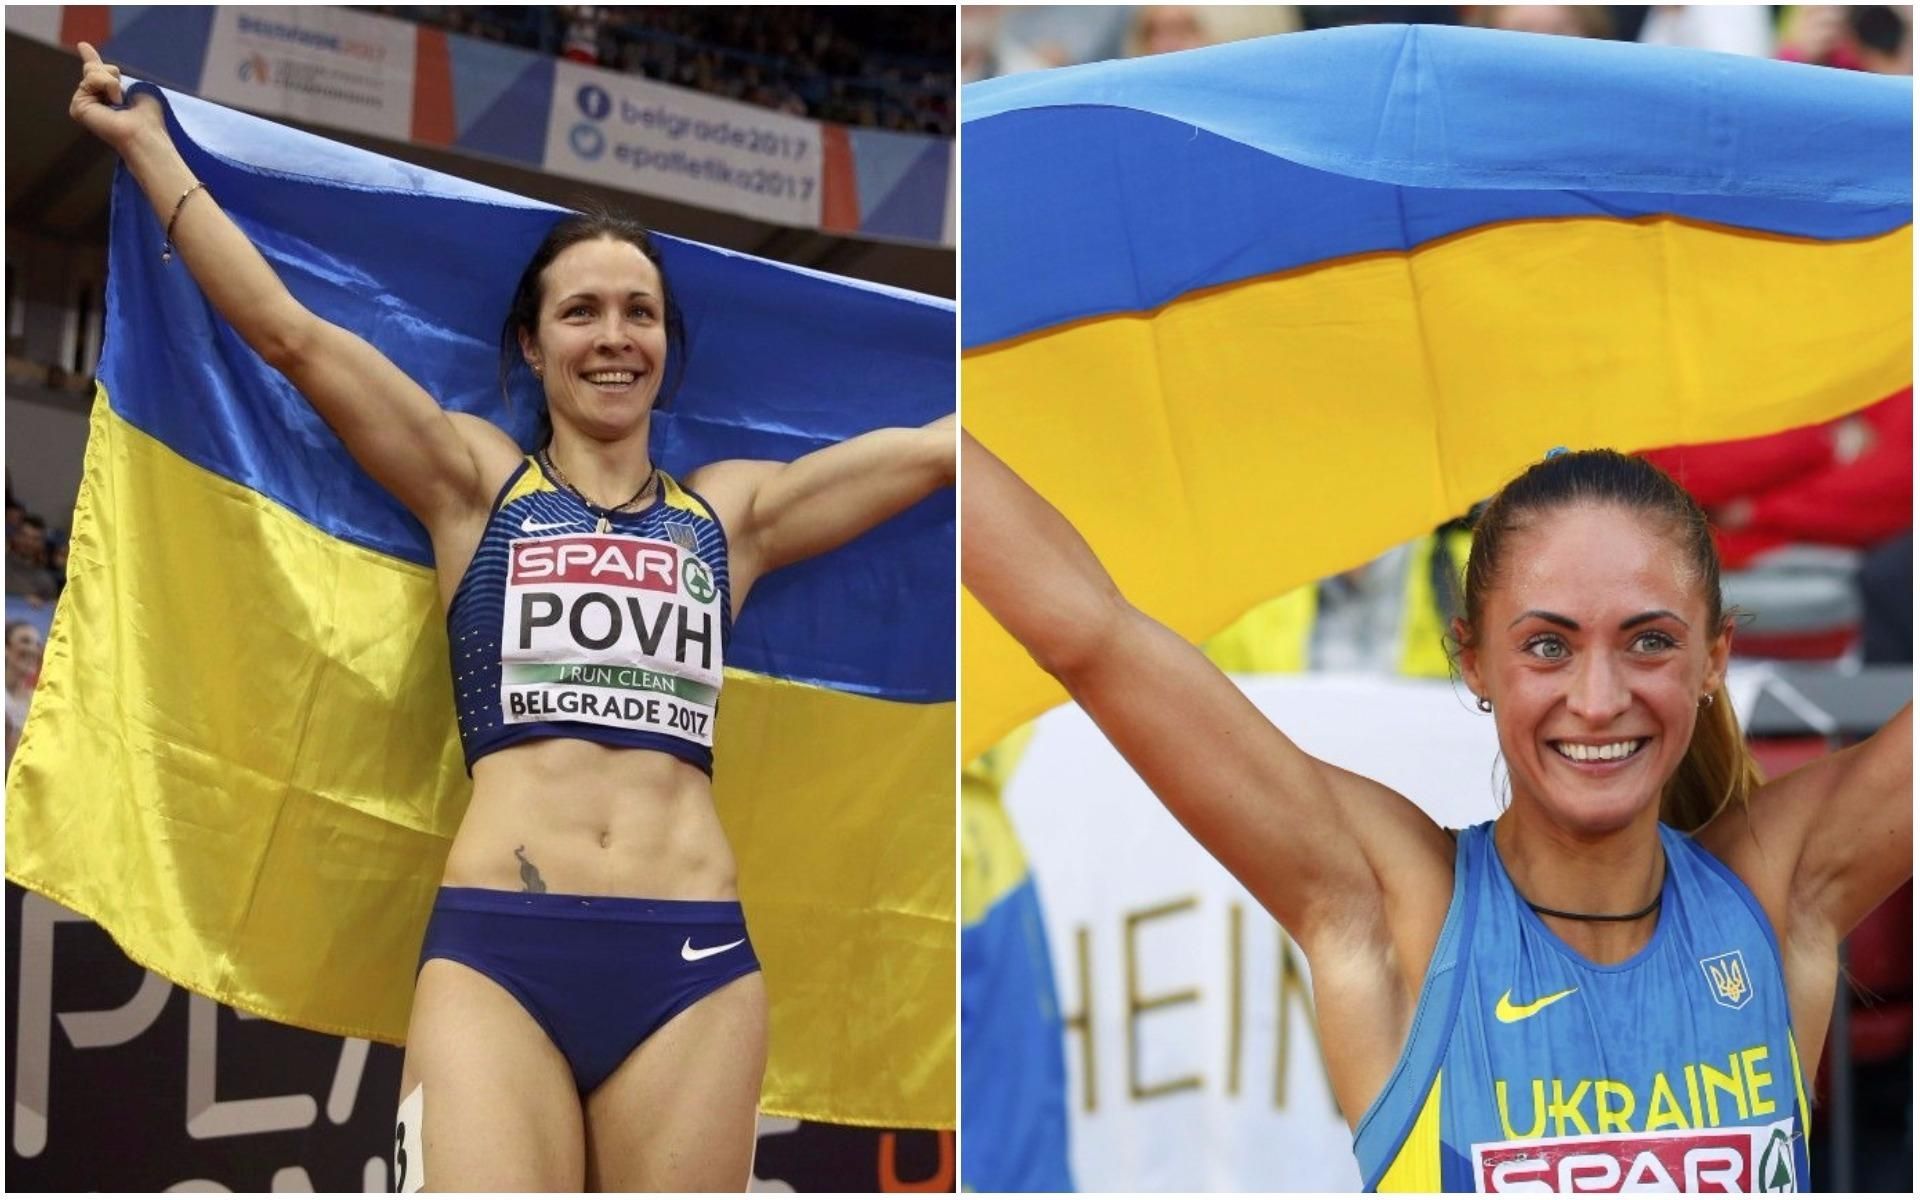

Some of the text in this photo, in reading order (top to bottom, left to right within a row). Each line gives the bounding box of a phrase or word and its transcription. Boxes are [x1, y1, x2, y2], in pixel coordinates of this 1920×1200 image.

[517, 543, 673, 586] SPAR
[519, 592, 712, 670] POVH
[570, 667, 613, 684] RUN
[618, 669, 676, 692] CLEAN
[509, 690, 661, 725] BELGRADE
[1496, 1046, 1776, 1141] UKRAINE
[1491, 1147, 1747, 1193] SPAR
